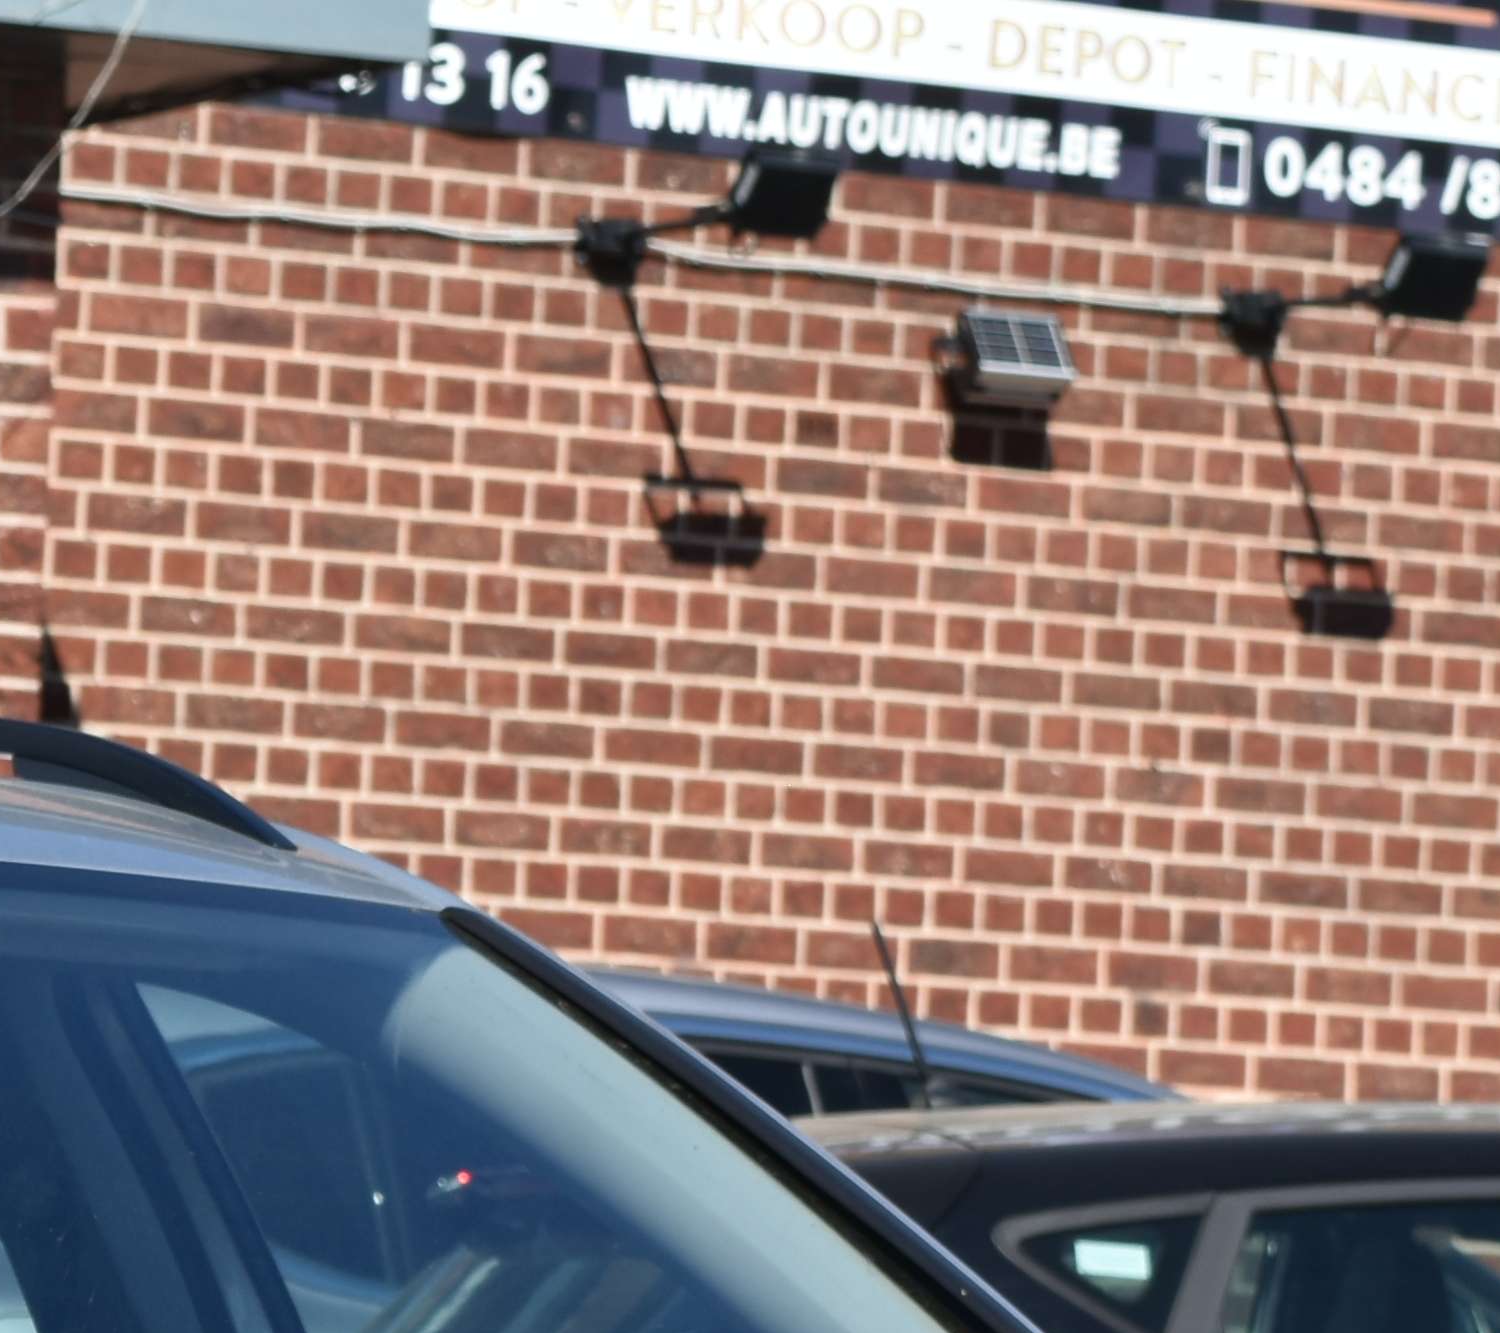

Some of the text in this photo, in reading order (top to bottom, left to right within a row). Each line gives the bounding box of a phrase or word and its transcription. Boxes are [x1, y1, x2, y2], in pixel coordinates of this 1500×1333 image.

[485, 49, 549, 116] 16
[988, 18, 1188, 87] DEPOT
[625, 76, 1121, 178] WWW.AUTOUNIQUE.BE
[1263, 136, 1426, 207] 0484
